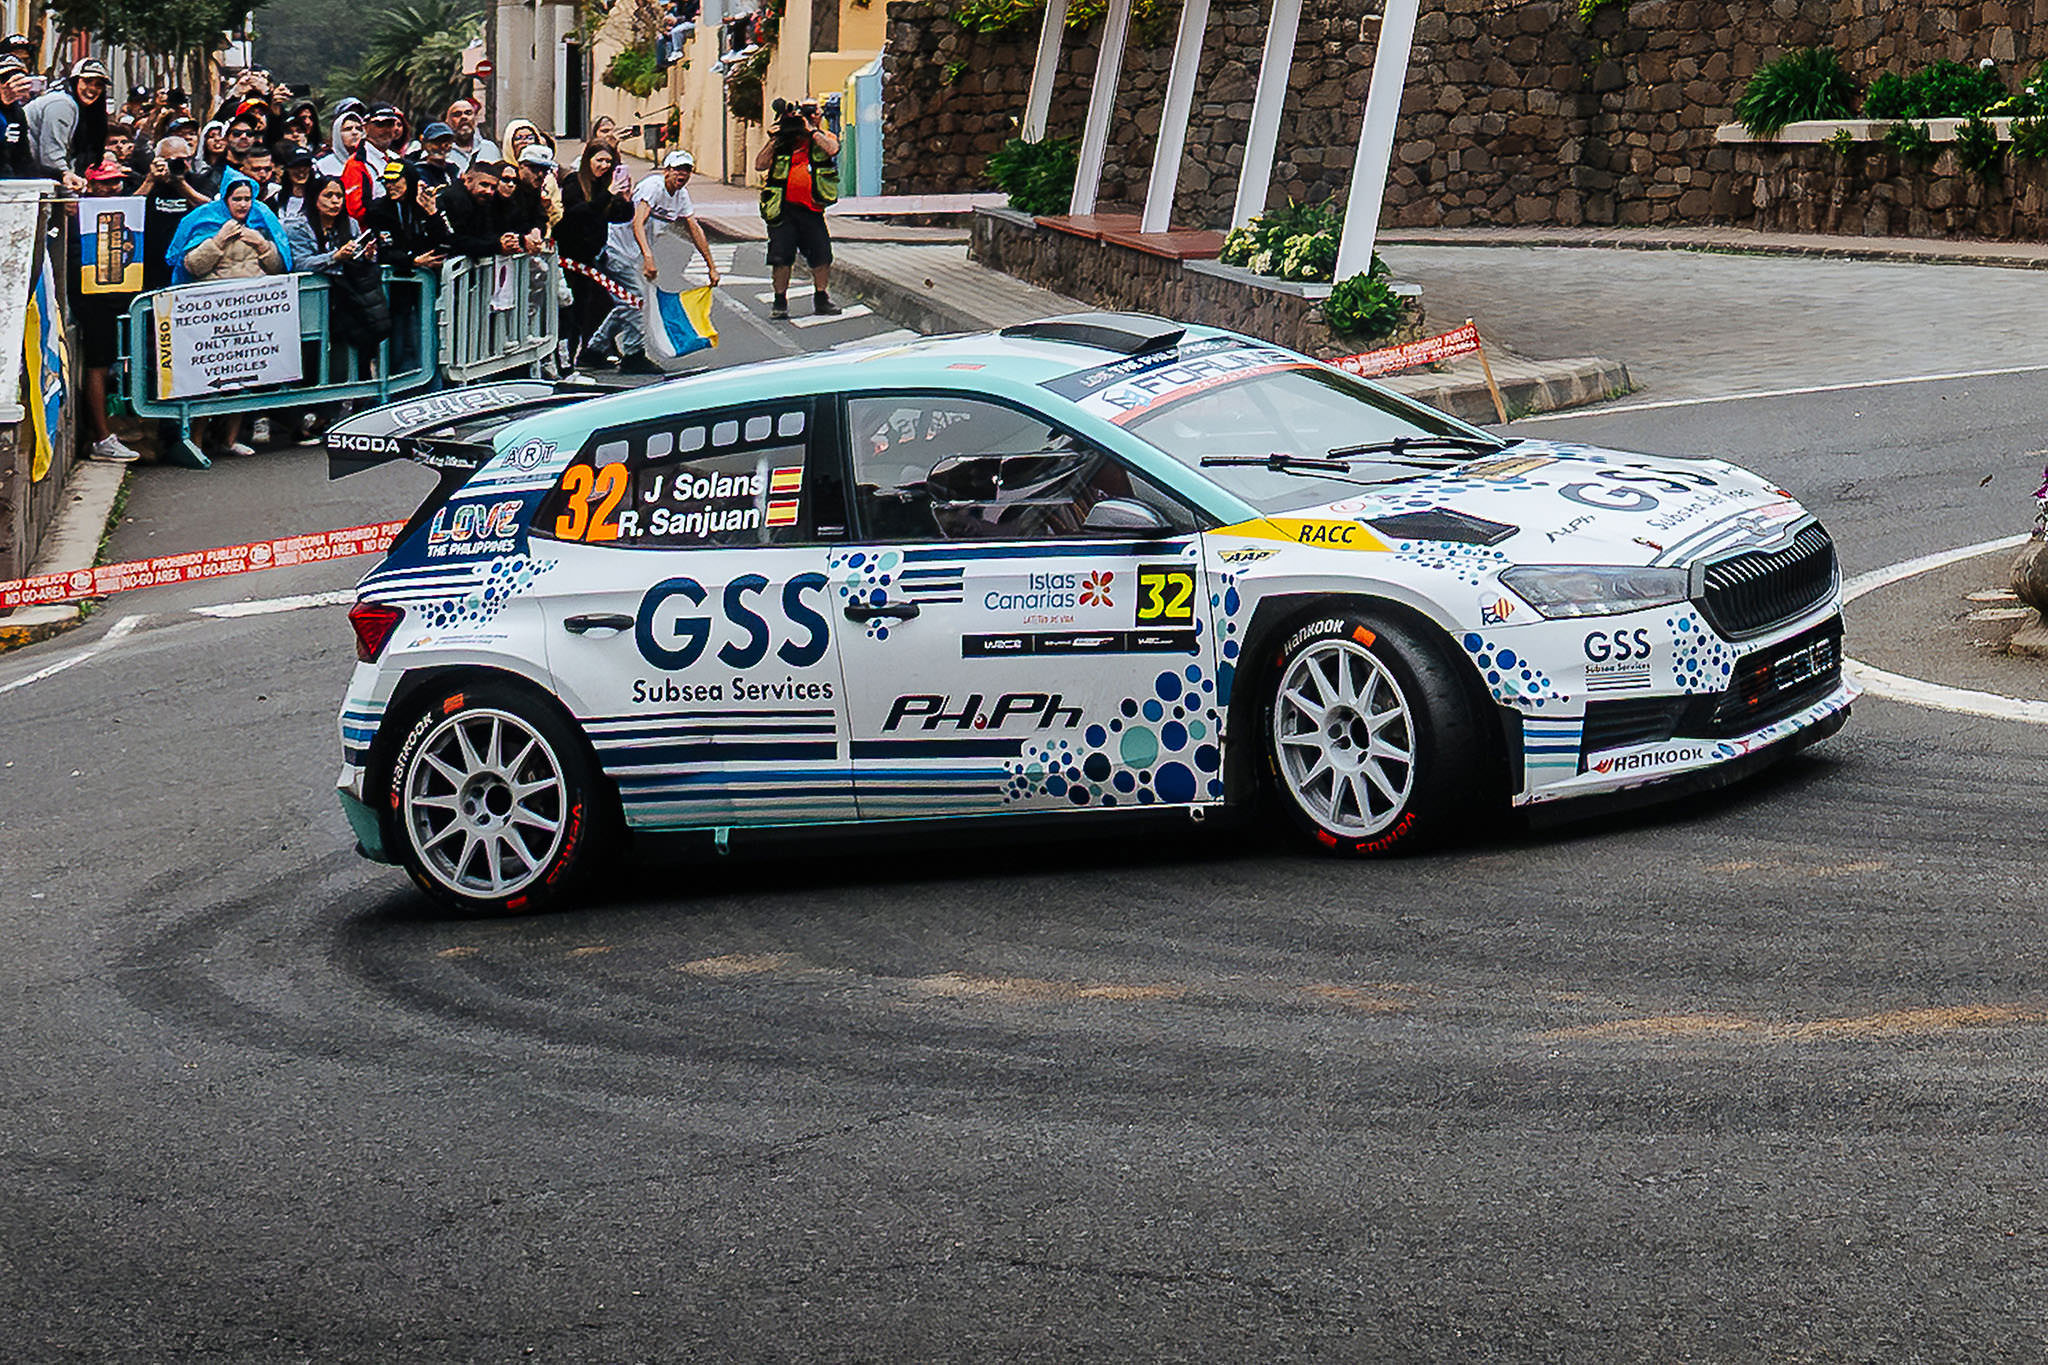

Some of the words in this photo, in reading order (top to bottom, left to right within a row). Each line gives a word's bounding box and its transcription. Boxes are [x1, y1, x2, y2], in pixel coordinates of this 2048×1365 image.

[177, 300, 212, 313] SOLO
[215, 290, 288, 308] VEHICULOS
[175, 303, 291, 327] RECONOCIMIENTO
[214, 321, 255, 335] RALLY
[159, 321, 172, 370] AVISO
[195, 338, 230, 351] ONLY
[233, 332, 274, 346] RALLY
[191, 345, 280, 366] RECOGNITION
[204, 360, 268, 377] VEHICLES
[643, 475, 664, 504] J
[672, 471, 766, 501] Solans
[554, 462, 629, 543] 32
[427, 500, 524, 545] LOVE
[617, 511, 645, 538] R.
[649, 506, 761, 538] Sanjuan
[1298, 525, 1357, 544] RACC
[332, 542, 358, 557] AREA
[427, 543, 449, 558] THE
[451, 538, 517, 556] PHILIPPINES
[155, 567, 182, 584] AREA
[1029, 572, 1076, 591] Islas
[984, 591, 1076, 611] Canarias
[1138, 572, 1194, 619] 32
[635, 573, 831, 671] GSS
[1584, 628, 1652, 663] GSS
[632, 679, 723, 703] Subsea
[732, 676, 834, 702] Services
